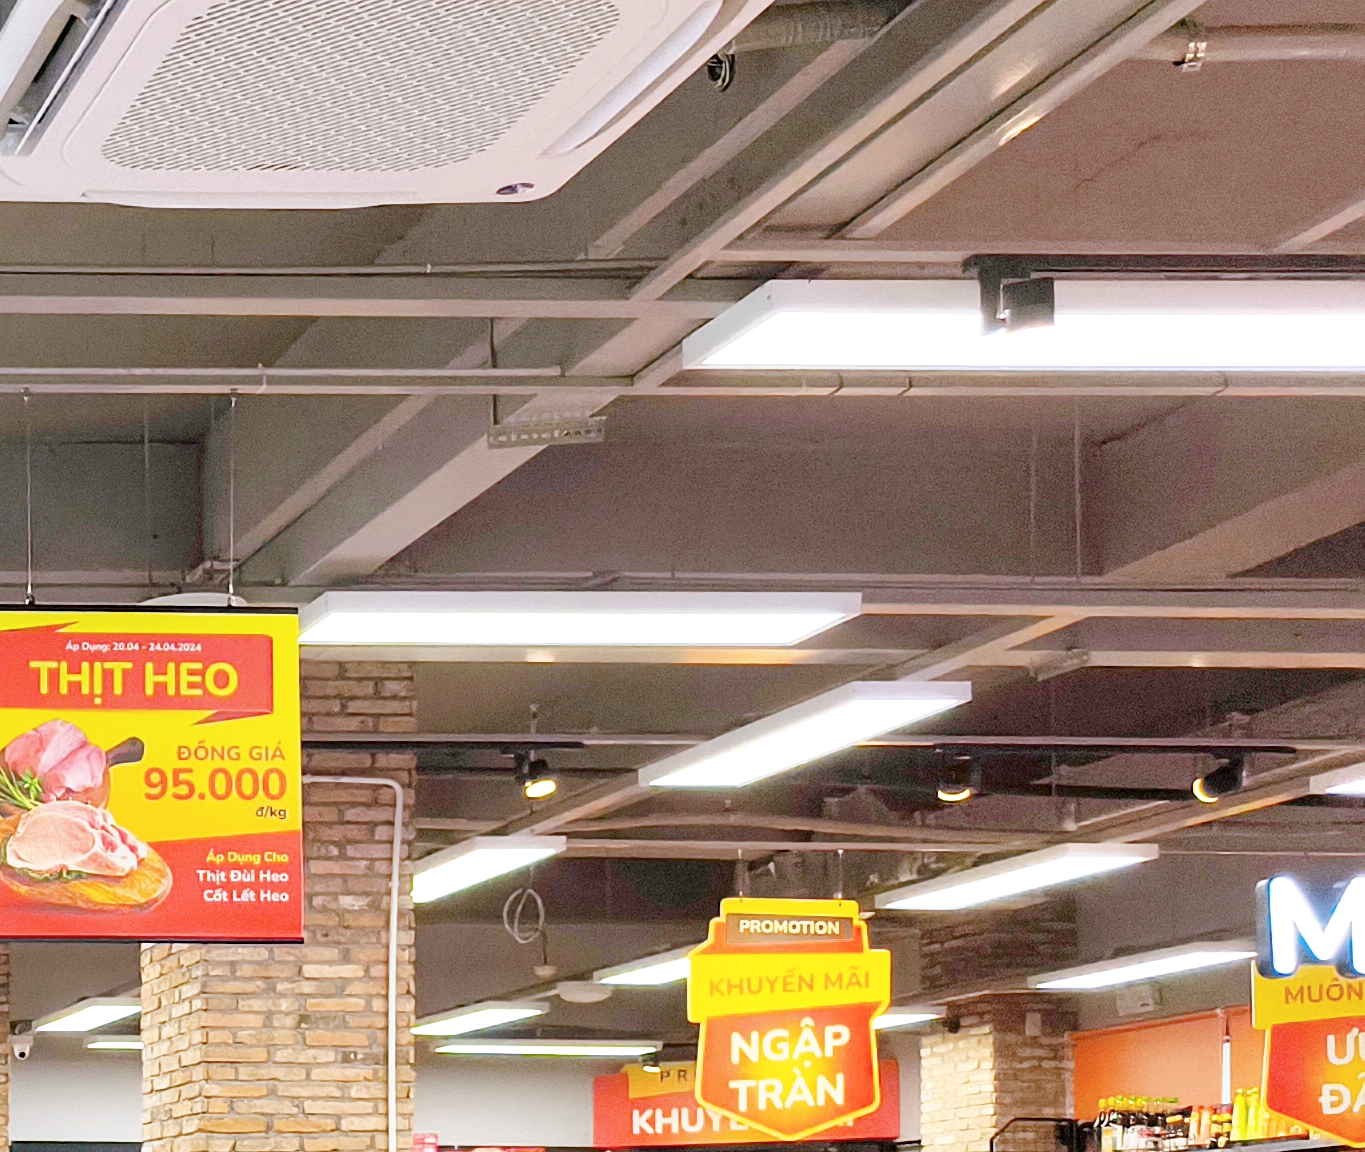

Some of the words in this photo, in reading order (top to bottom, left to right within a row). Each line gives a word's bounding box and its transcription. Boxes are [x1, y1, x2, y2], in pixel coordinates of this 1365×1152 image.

[65, 639, 79, 651] Áp
[82, 641, 110, 653] Dụng:
[113, 642, 139, 651] 20.04
[149, 642, 201, 652] 24.04.2024
[29, 661, 133, 705] THỊT
[145, 661, 238, 697] HEO
[177, 739, 241, 761] ĐỒNG
[248, 741, 286, 761] GIÁ
[144, 767, 287, 801] 95.000
[256, 806, 287, 820] đ/kg
[206, 849, 224, 864] Áp
[228, 851, 261, 866] Dụng
[264, 851, 289, 863] Cho
[196, 869, 226, 885] Thịt
[230, 869, 255, 882] Đùi
[259, 870, 288, 882] Heo
[203, 888, 228, 902] Cốt
[232, 888, 256, 902] Lết
[259, 889, 289, 902] Heo
[739, 919, 840, 935] PROMOTION
[710, 966, 814, 997] KHUYẾN
[824, 966, 870, 991] MÃI
[1284, 977, 1365, 1005] MUÔN
[731, 1017, 850, 1068] NGẬP
[729, 1067, 845, 1113] TRÀN
